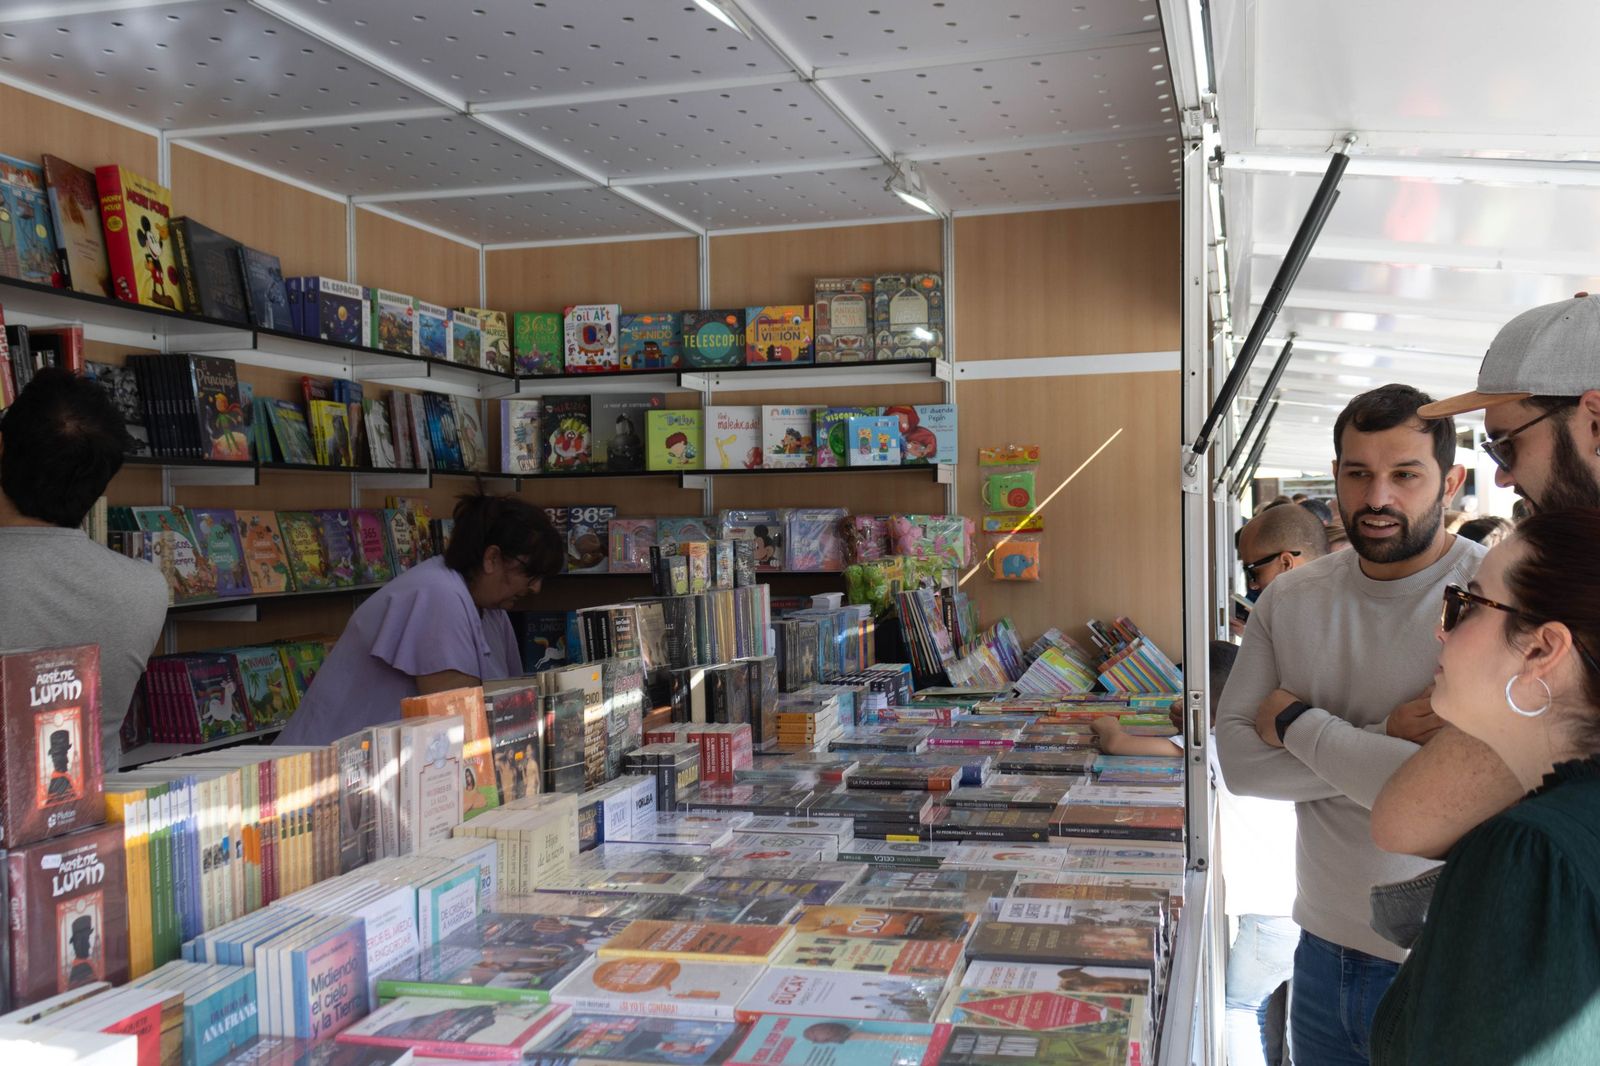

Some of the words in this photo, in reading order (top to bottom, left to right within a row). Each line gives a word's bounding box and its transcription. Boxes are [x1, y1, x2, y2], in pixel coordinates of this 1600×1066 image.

[518, 315, 558, 334] 365
[571, 310, 590, 322] Foil
[594, 309, 611, 321] Art
[631, 330, 673, 340] SONIDO
[683, 334, 745, 348] TELESCOPIO
[570, 507, 614, 523] 365
[363, 528, 377, 538] 365
[311, 957, 358, 996] Midiendo
[312, 994, 322, 1015] el
[324, 982, 348, 1008] cielo
[774, 975, 809, 1006] BUCAY
[202, 1022, 223, 1045] ANA
[223, 1003, 257, 1034] FRANK
[312, 1021, 319, 1041] y
[321, 1013, 331, 1031] la
[333, 997, 360, 1021] Tierra
